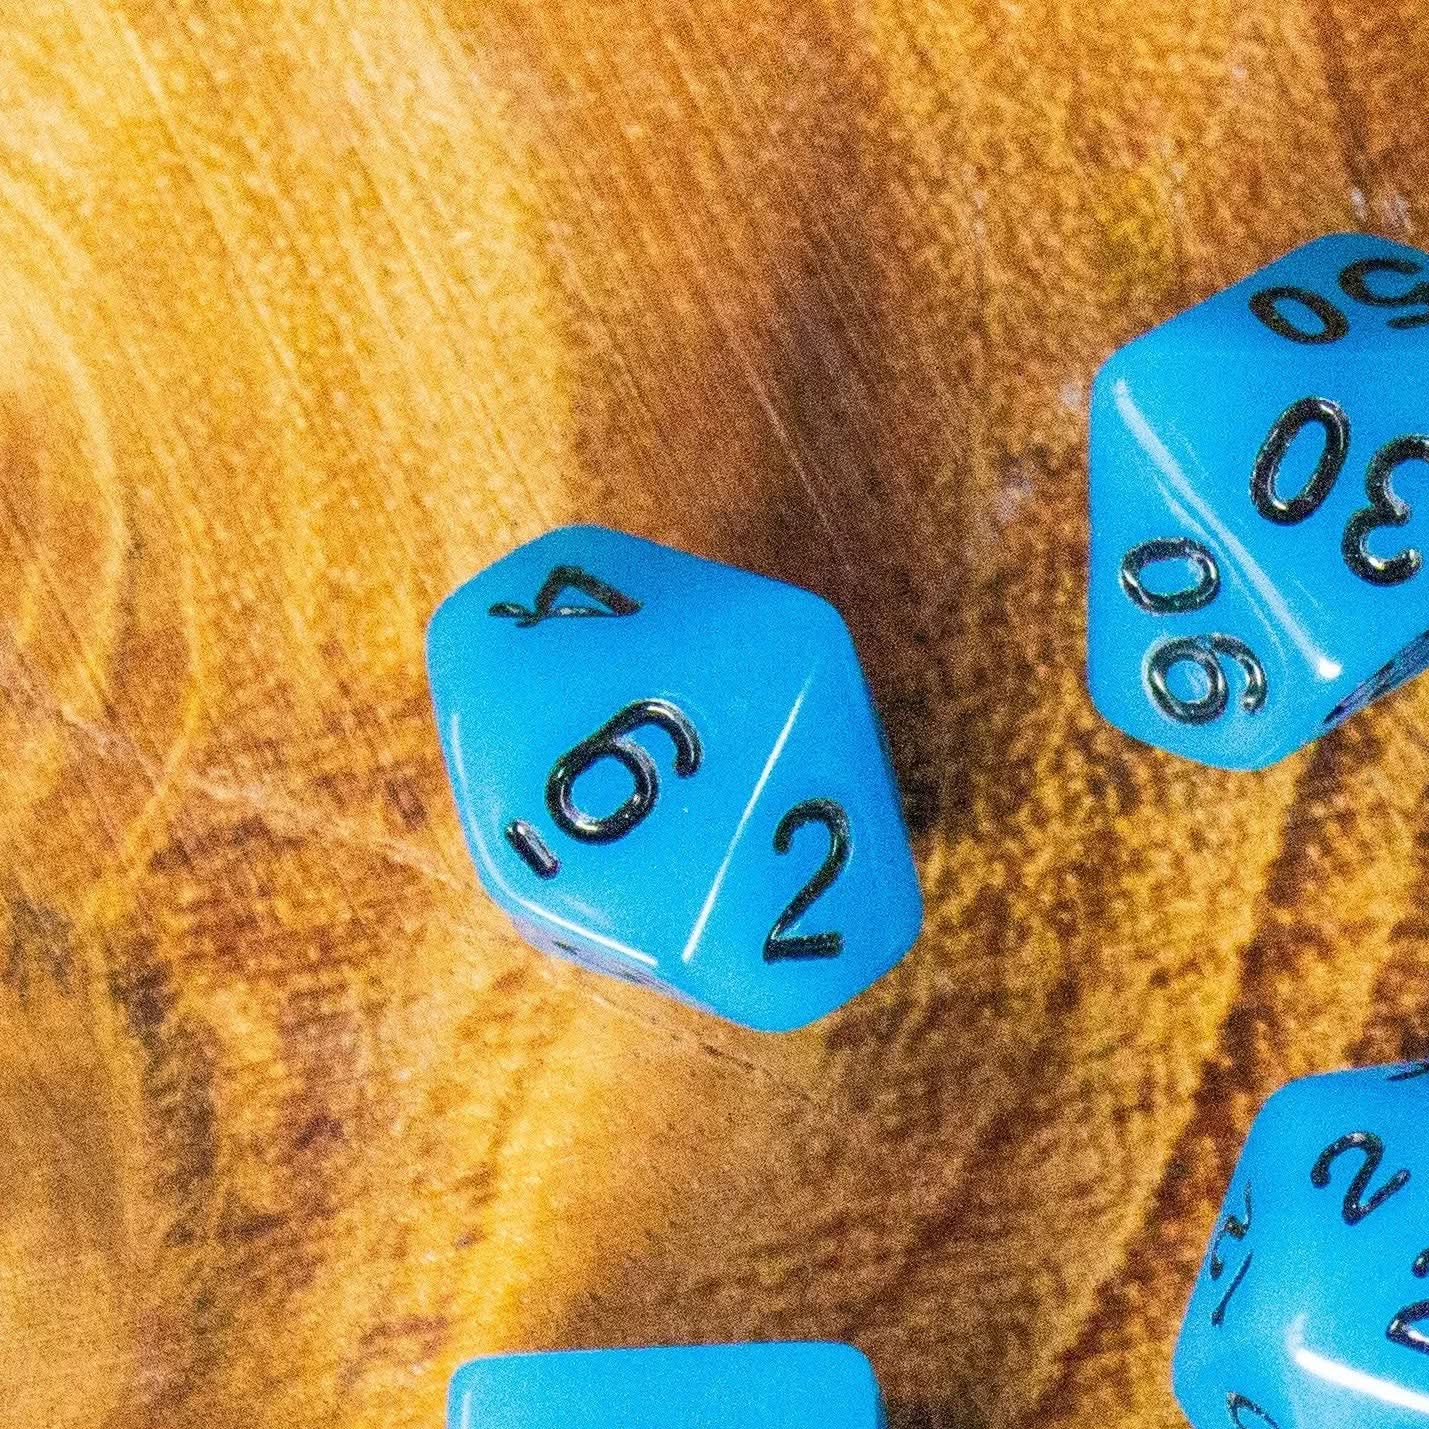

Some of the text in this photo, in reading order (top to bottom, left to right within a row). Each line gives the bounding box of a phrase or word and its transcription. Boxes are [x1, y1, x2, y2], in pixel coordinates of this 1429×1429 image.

[488, 564, 644, 628] 4
[1119, 535, 1268, 725] 90
[763, 797, 851, 965] 2
[1310, 1130, 1411, 1226] 2
